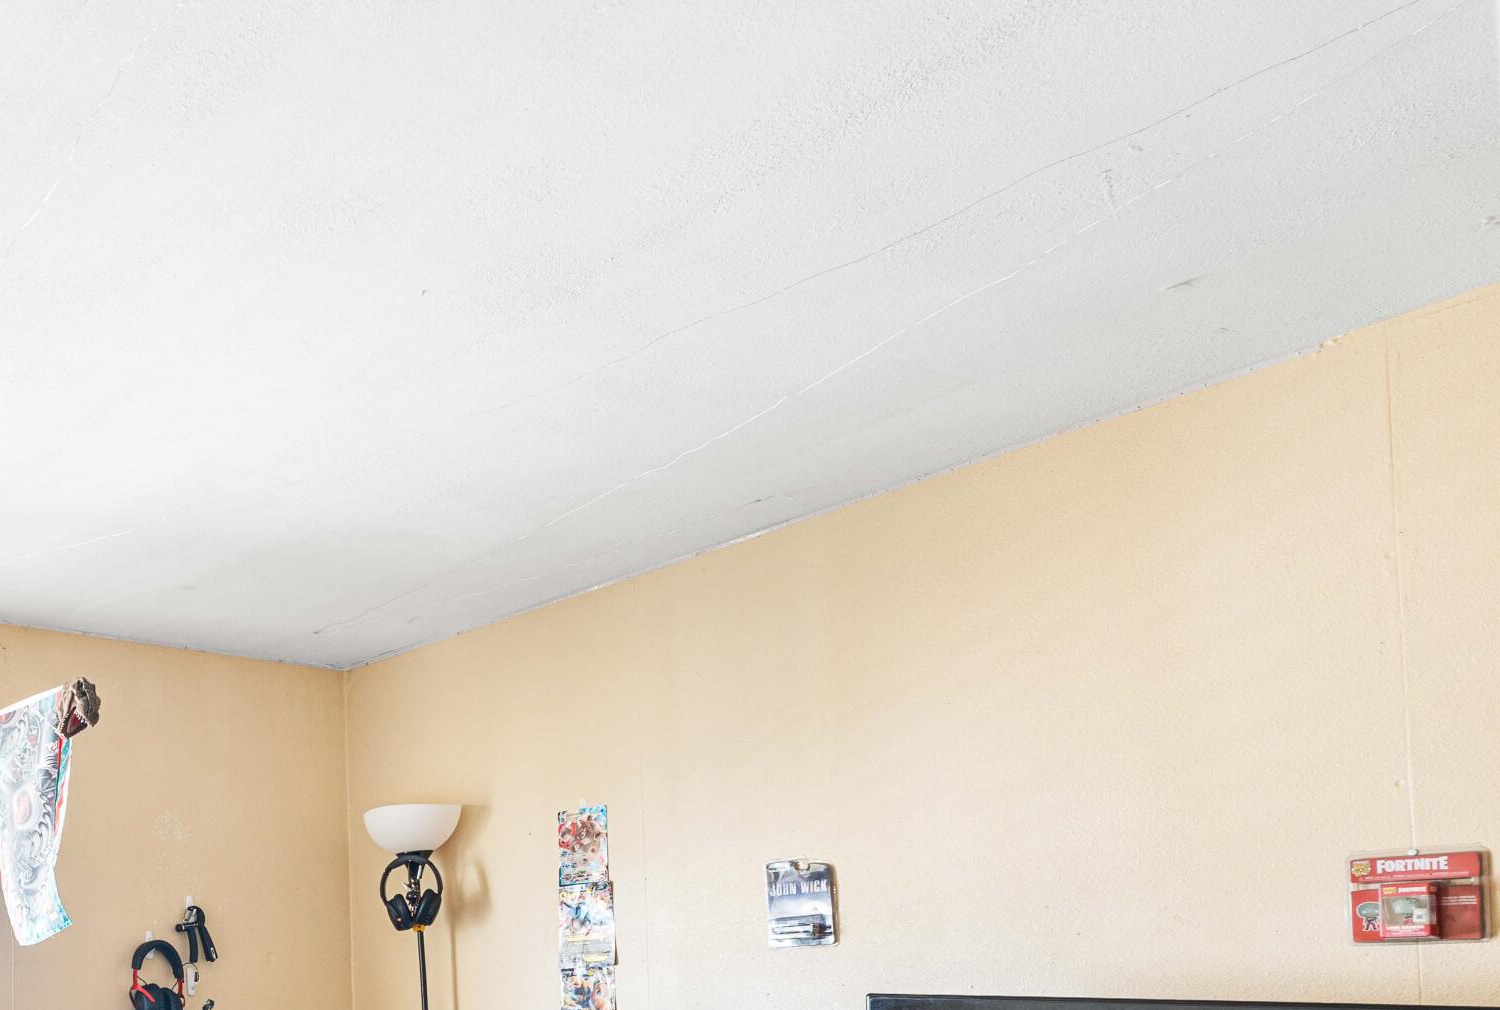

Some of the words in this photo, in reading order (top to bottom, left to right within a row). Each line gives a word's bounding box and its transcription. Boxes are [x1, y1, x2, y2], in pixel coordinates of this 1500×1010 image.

[1376, 856, 1449, 874] FORTNITE
[770, 882, 797, 897] JOHN
[801, 879, 828, 893] WICK
